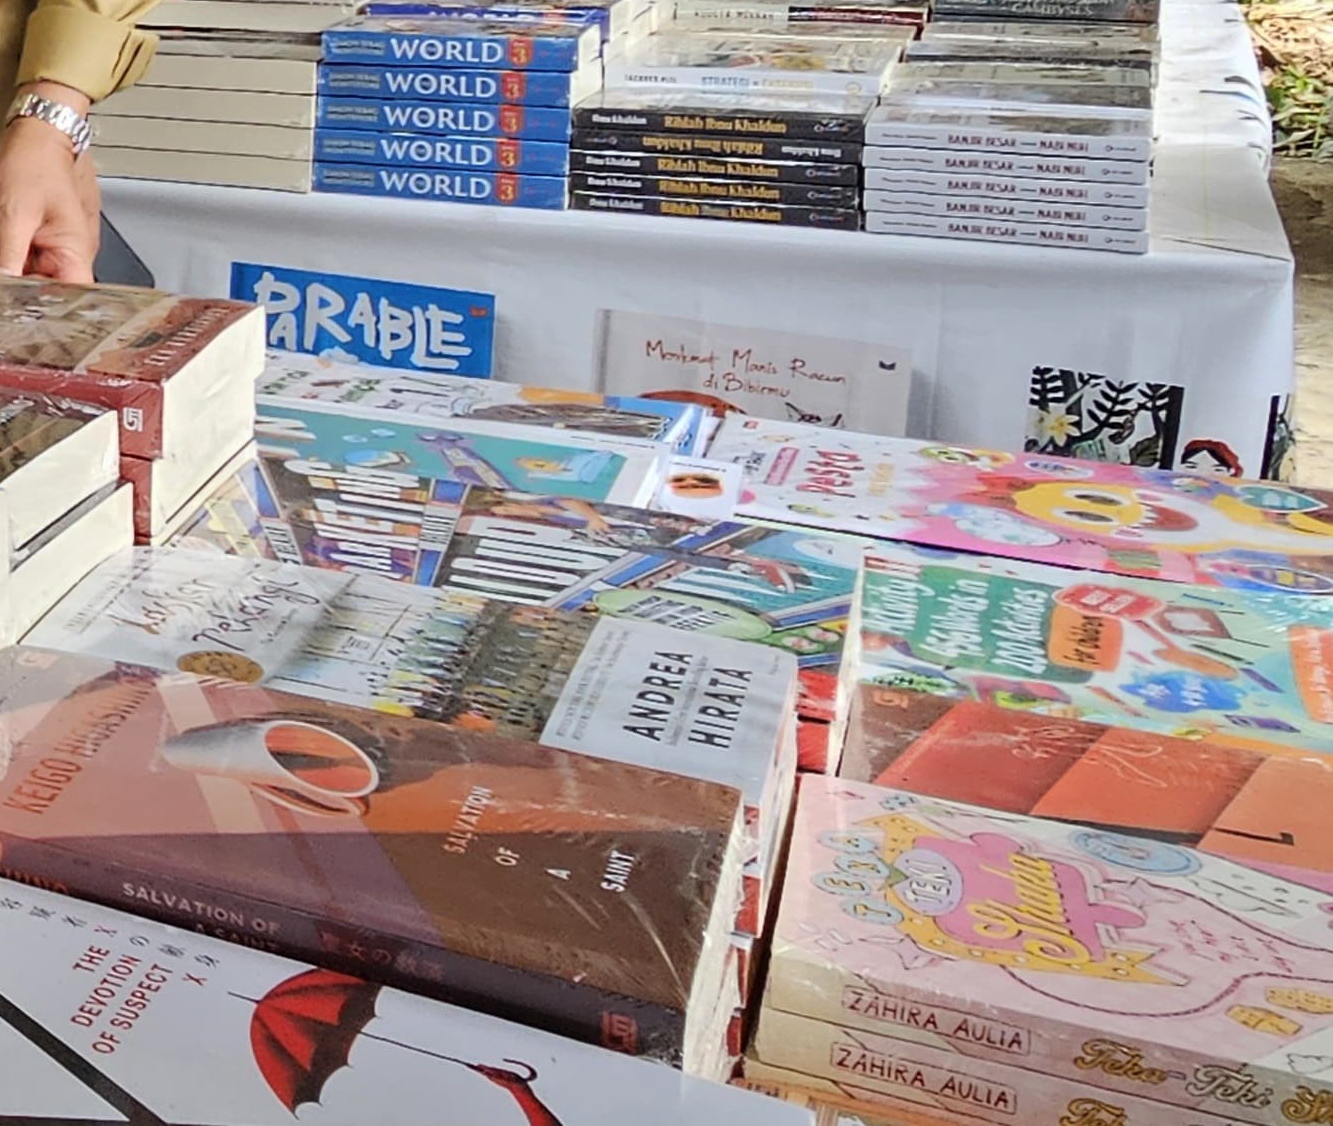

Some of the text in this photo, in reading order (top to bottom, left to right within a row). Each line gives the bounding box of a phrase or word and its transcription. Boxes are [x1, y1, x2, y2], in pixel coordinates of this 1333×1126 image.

[390, 39, 503, 62] WORLD
[512, 46, 528, 62] 3
[385, 73, 496, 98] WORLD
[507, 82, 520, 99] 3
[384, 106, 494, 131] WORLD
[506, 115, 518, 133] 3
[735, 120, 786, 134] Khaldun
[380, 140, 492, 166] WORLD
[501, 149, 515, 166] 3
[643, 136, 692, 151] Khaldun
[986, 136, 1016, 148] BESAR
[728, 163, 778, 177] Khaldun
[983, 160, 1014, 171] BESAR
[380, 171, 490, 198] WORLD
[500, 183, 514, 202] 3
[730, 185, 779, 199] Khaldun
[985, 182, 1016, 193] BESAR
[731, 207, 781, 221] Khaldun
[984, 204, 1014, 215] BESAR
[986, 225, 1017, 237] BESAR
[733, 349, 846, 384] Manis Racun
[703, 372, 790, 398] di Bibirmu
[992, 643, 1049, 674] 200
[623, 651, 693, 742] ANDREA
[687, 667, 753, 749] HIRATA
[3, 758, 81, 815] KEIGO
[441, 785, 493, 855] SALVATION
[495, 846, 520, 867] OF
[547, 867, 571, 881] A
[600, 847, 635, 894] SAINT
[122, 881, 279, 933] SALVATION OF
[71, 943, 110, 973] THE
[69, 954, 142, 1028] DEVOTION
[185, 972, 207, 987] X
[91, 963, 175, 1055] OF SUSPECT
[847, 988, 1024, 1051] ZAHIRA AULIA
[836, 1045, 1011, 1110] ZAHIRA AULIA
